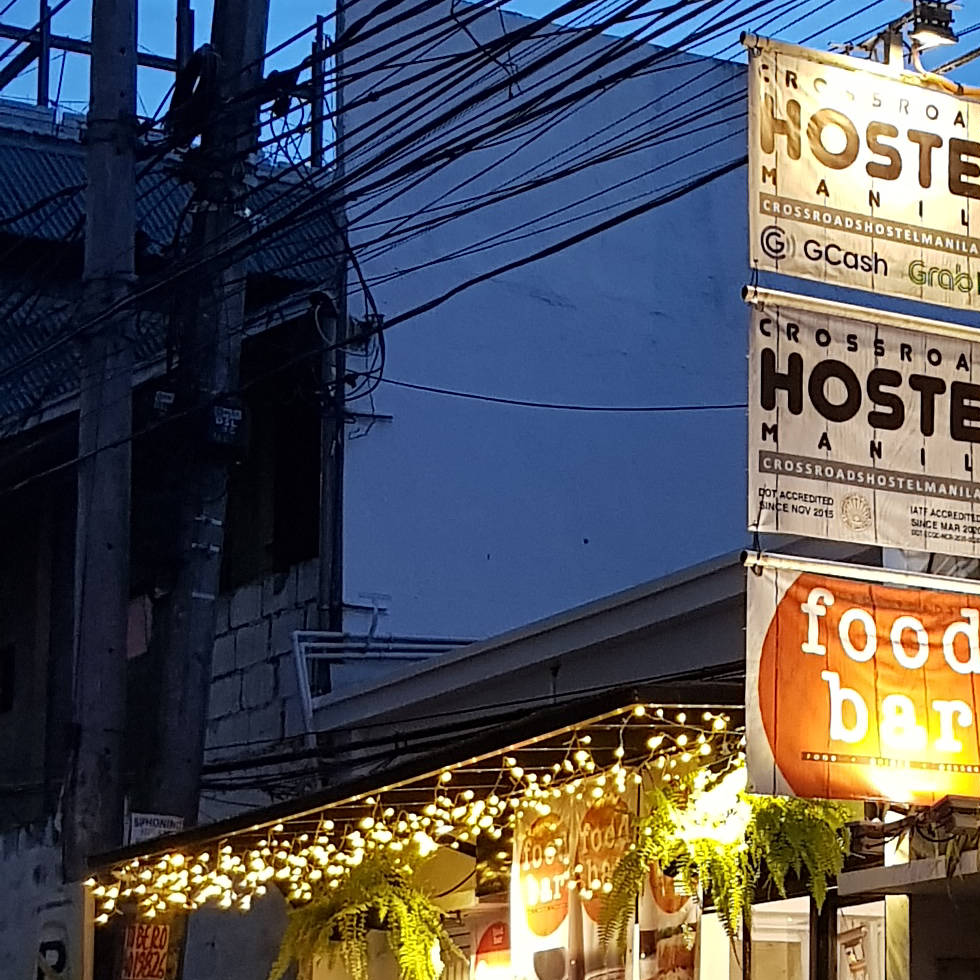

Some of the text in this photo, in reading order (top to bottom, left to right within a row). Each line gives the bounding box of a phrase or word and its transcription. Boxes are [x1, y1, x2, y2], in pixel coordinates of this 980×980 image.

[804, 239, 888, 276] GCash
[780, 491, 834, 506] ACCREDITED
[791, 504, 811, 515] NOV
[911, 518, 938, 530] SINCE
[821, 670, 973, 753] bar
